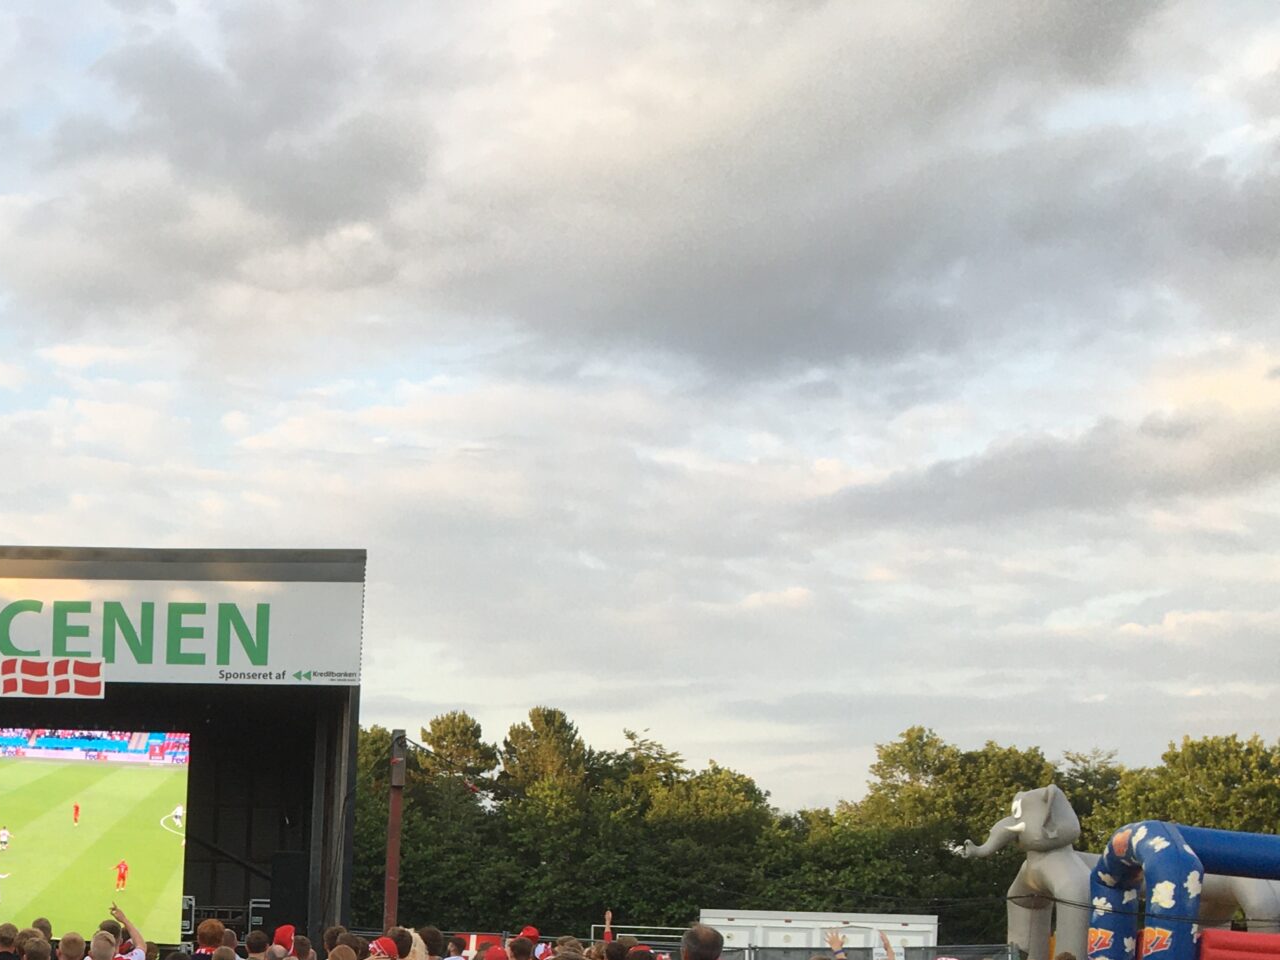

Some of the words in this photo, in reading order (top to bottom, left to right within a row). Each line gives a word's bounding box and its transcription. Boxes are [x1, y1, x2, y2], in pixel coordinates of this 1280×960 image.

[218, 669, 273, 681] Sponseret
[275, 670, 286, 680] af
[85, 751, 108, 761] FedEx
